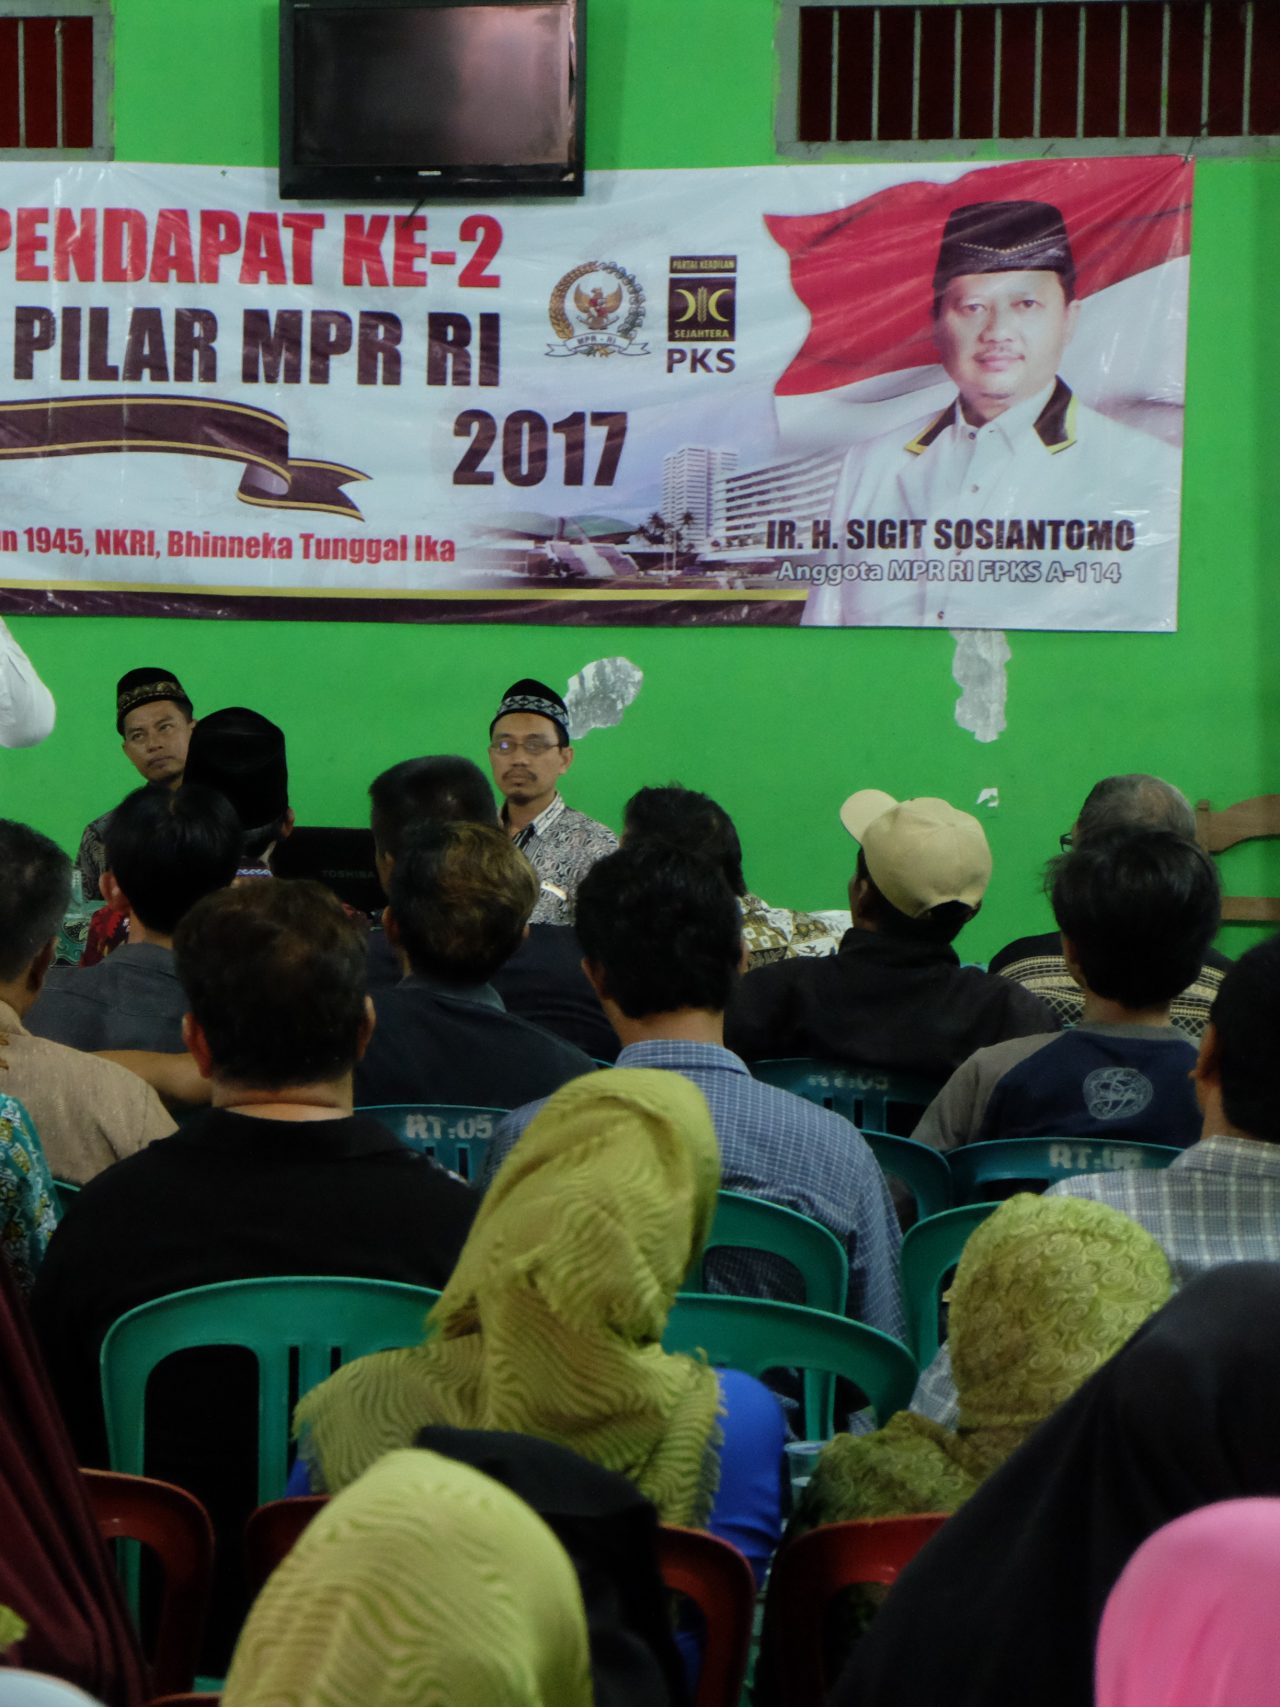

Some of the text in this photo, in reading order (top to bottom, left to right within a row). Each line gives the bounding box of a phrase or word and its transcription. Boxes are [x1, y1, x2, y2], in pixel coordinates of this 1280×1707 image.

[342, 214, 504, 288] KE-2
[671, 258, 735, 270] PARTAI KEADILAN
[13, 306, 218, 383] PILAR
[241, 308, 404, 386] MPR
[426, 312, 501, 387] RI
[576, 336, 597, 346] MPR
[673, 329, 730, 339] SEJAHTERA
[666, 347, 737, 374] PKS
[452, 408, 628, 487] 2017
[23, 526, 90, 558] 1945,
[95, 528, 161, 560] NKRI,
[166, 530, 293, 560] Bhinneka
[299, 533, 408, 564] Tunggal
[414, 534, 456, 562] Ika
[765, 518, 1136, 552] IR. H. SIGIT SOSIANTOMO
[777, 560, 1121, 586] Anggota MPR RI FPKS A-114
